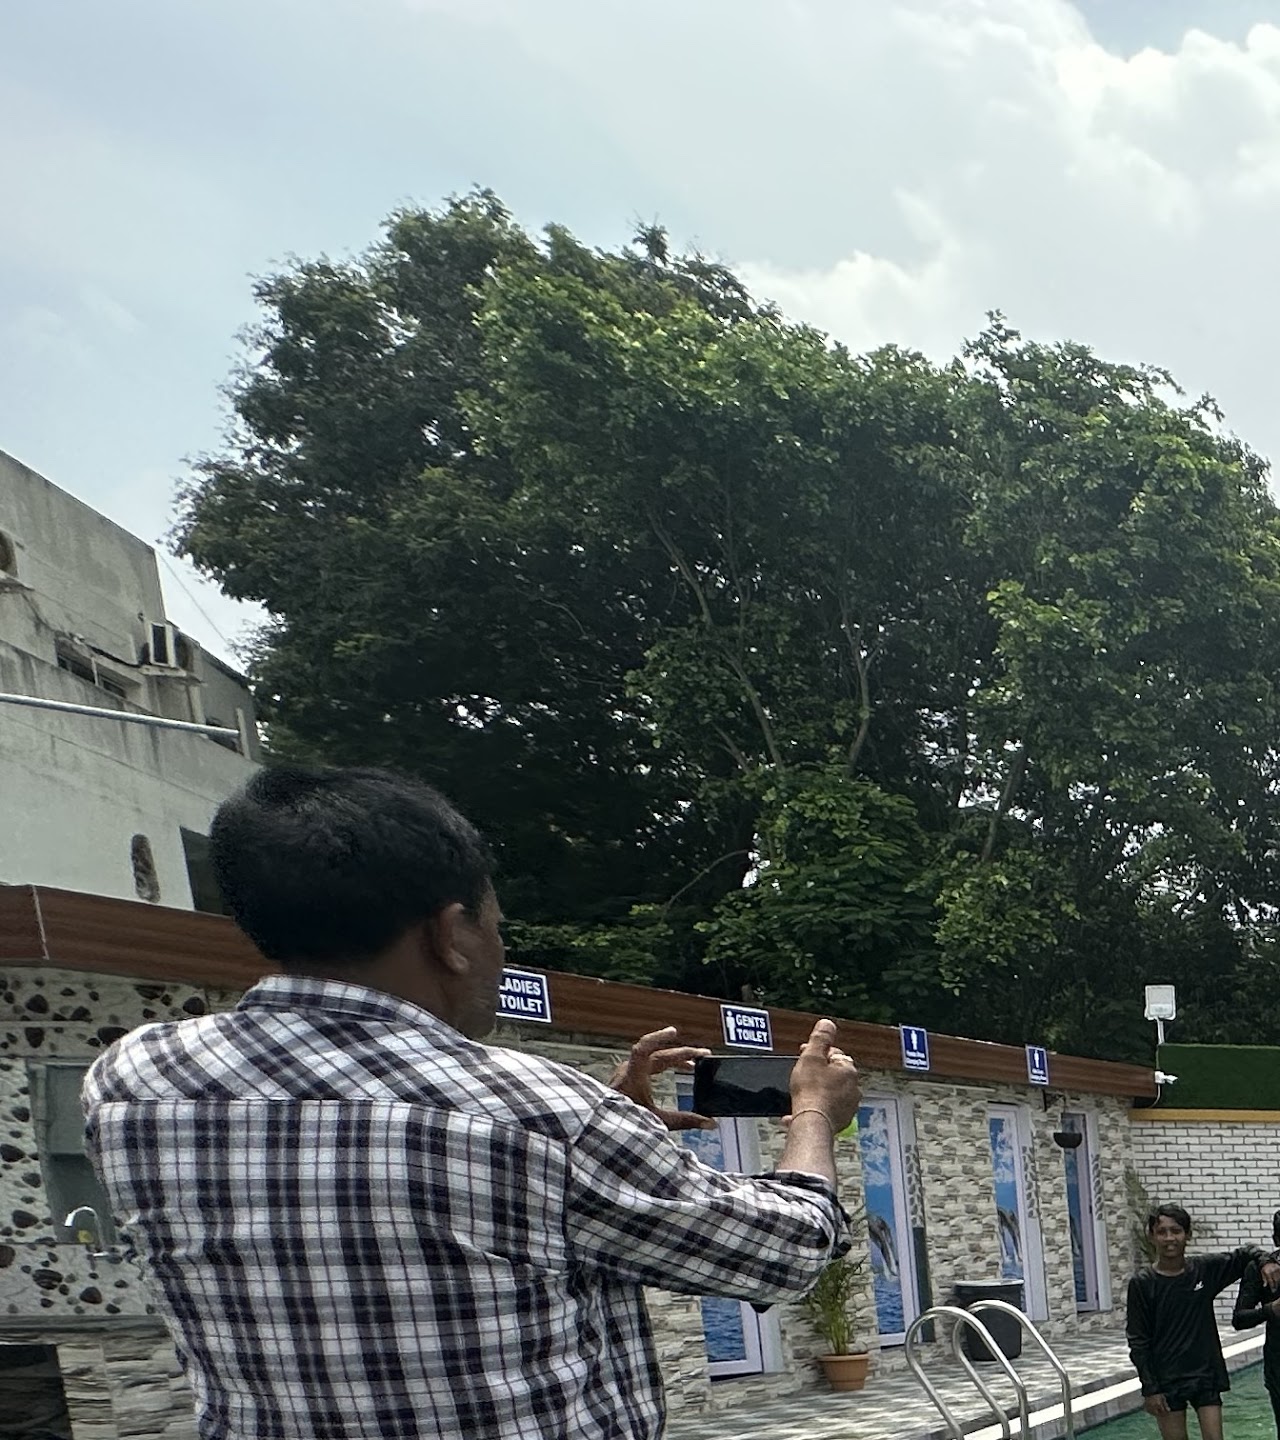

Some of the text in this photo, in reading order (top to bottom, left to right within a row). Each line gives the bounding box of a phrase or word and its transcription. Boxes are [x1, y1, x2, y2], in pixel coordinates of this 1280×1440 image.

[499, 993, 543, 1013] TOILET
[735, 1013, 766, 1029] GENTS
[735, 1027, 768, 1043] TOILET
